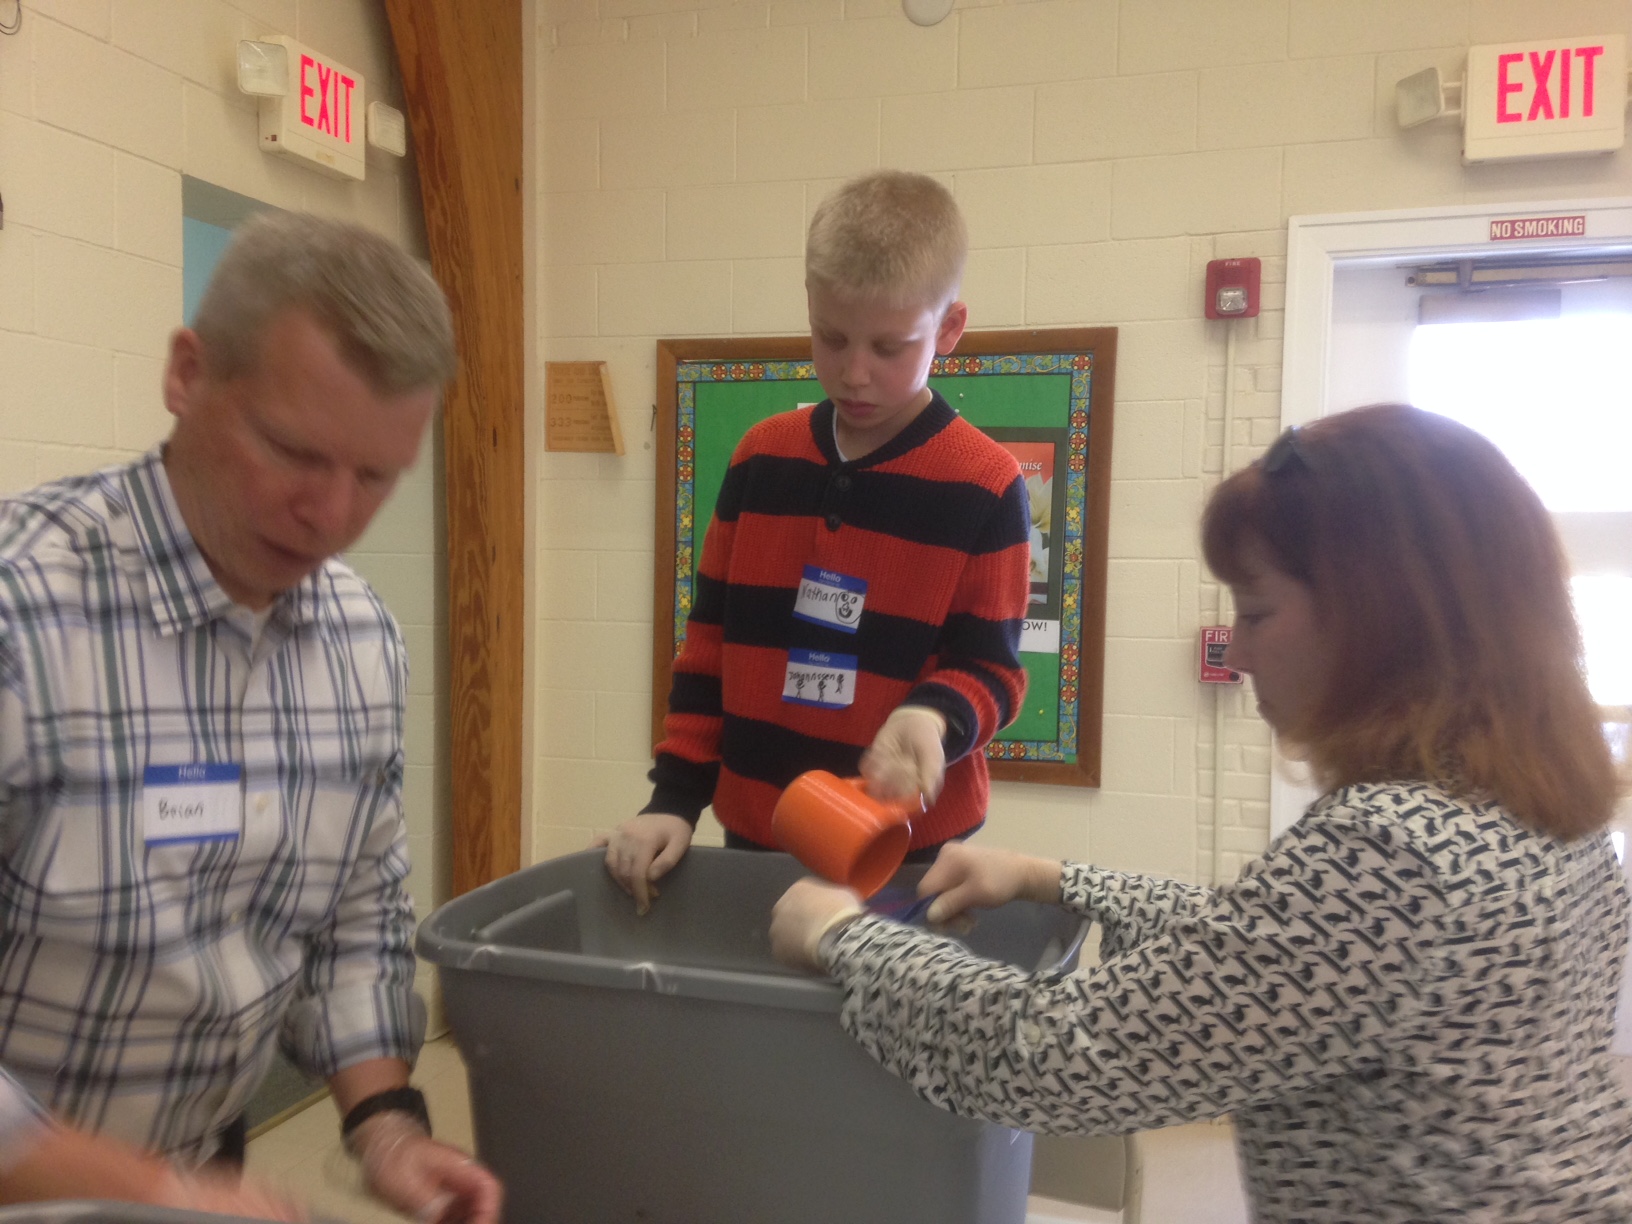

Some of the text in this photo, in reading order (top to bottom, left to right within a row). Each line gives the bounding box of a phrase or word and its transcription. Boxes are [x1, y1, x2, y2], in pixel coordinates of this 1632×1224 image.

[1496, 45, 1604, 124] EXIT
[300, 53, 356, 143] EXIT
[1491, 218, 1584, 239] NO SMOKING
[1018, 458, 1043, 471] mise
[819, 570, 842, 583] Hello
[1022, 620, 1047, 632] OW!
[1205, 630, 1232, 642] FIR
[808, 652, 831, 663] Hello
[179, 766, 206, 779] Hello
